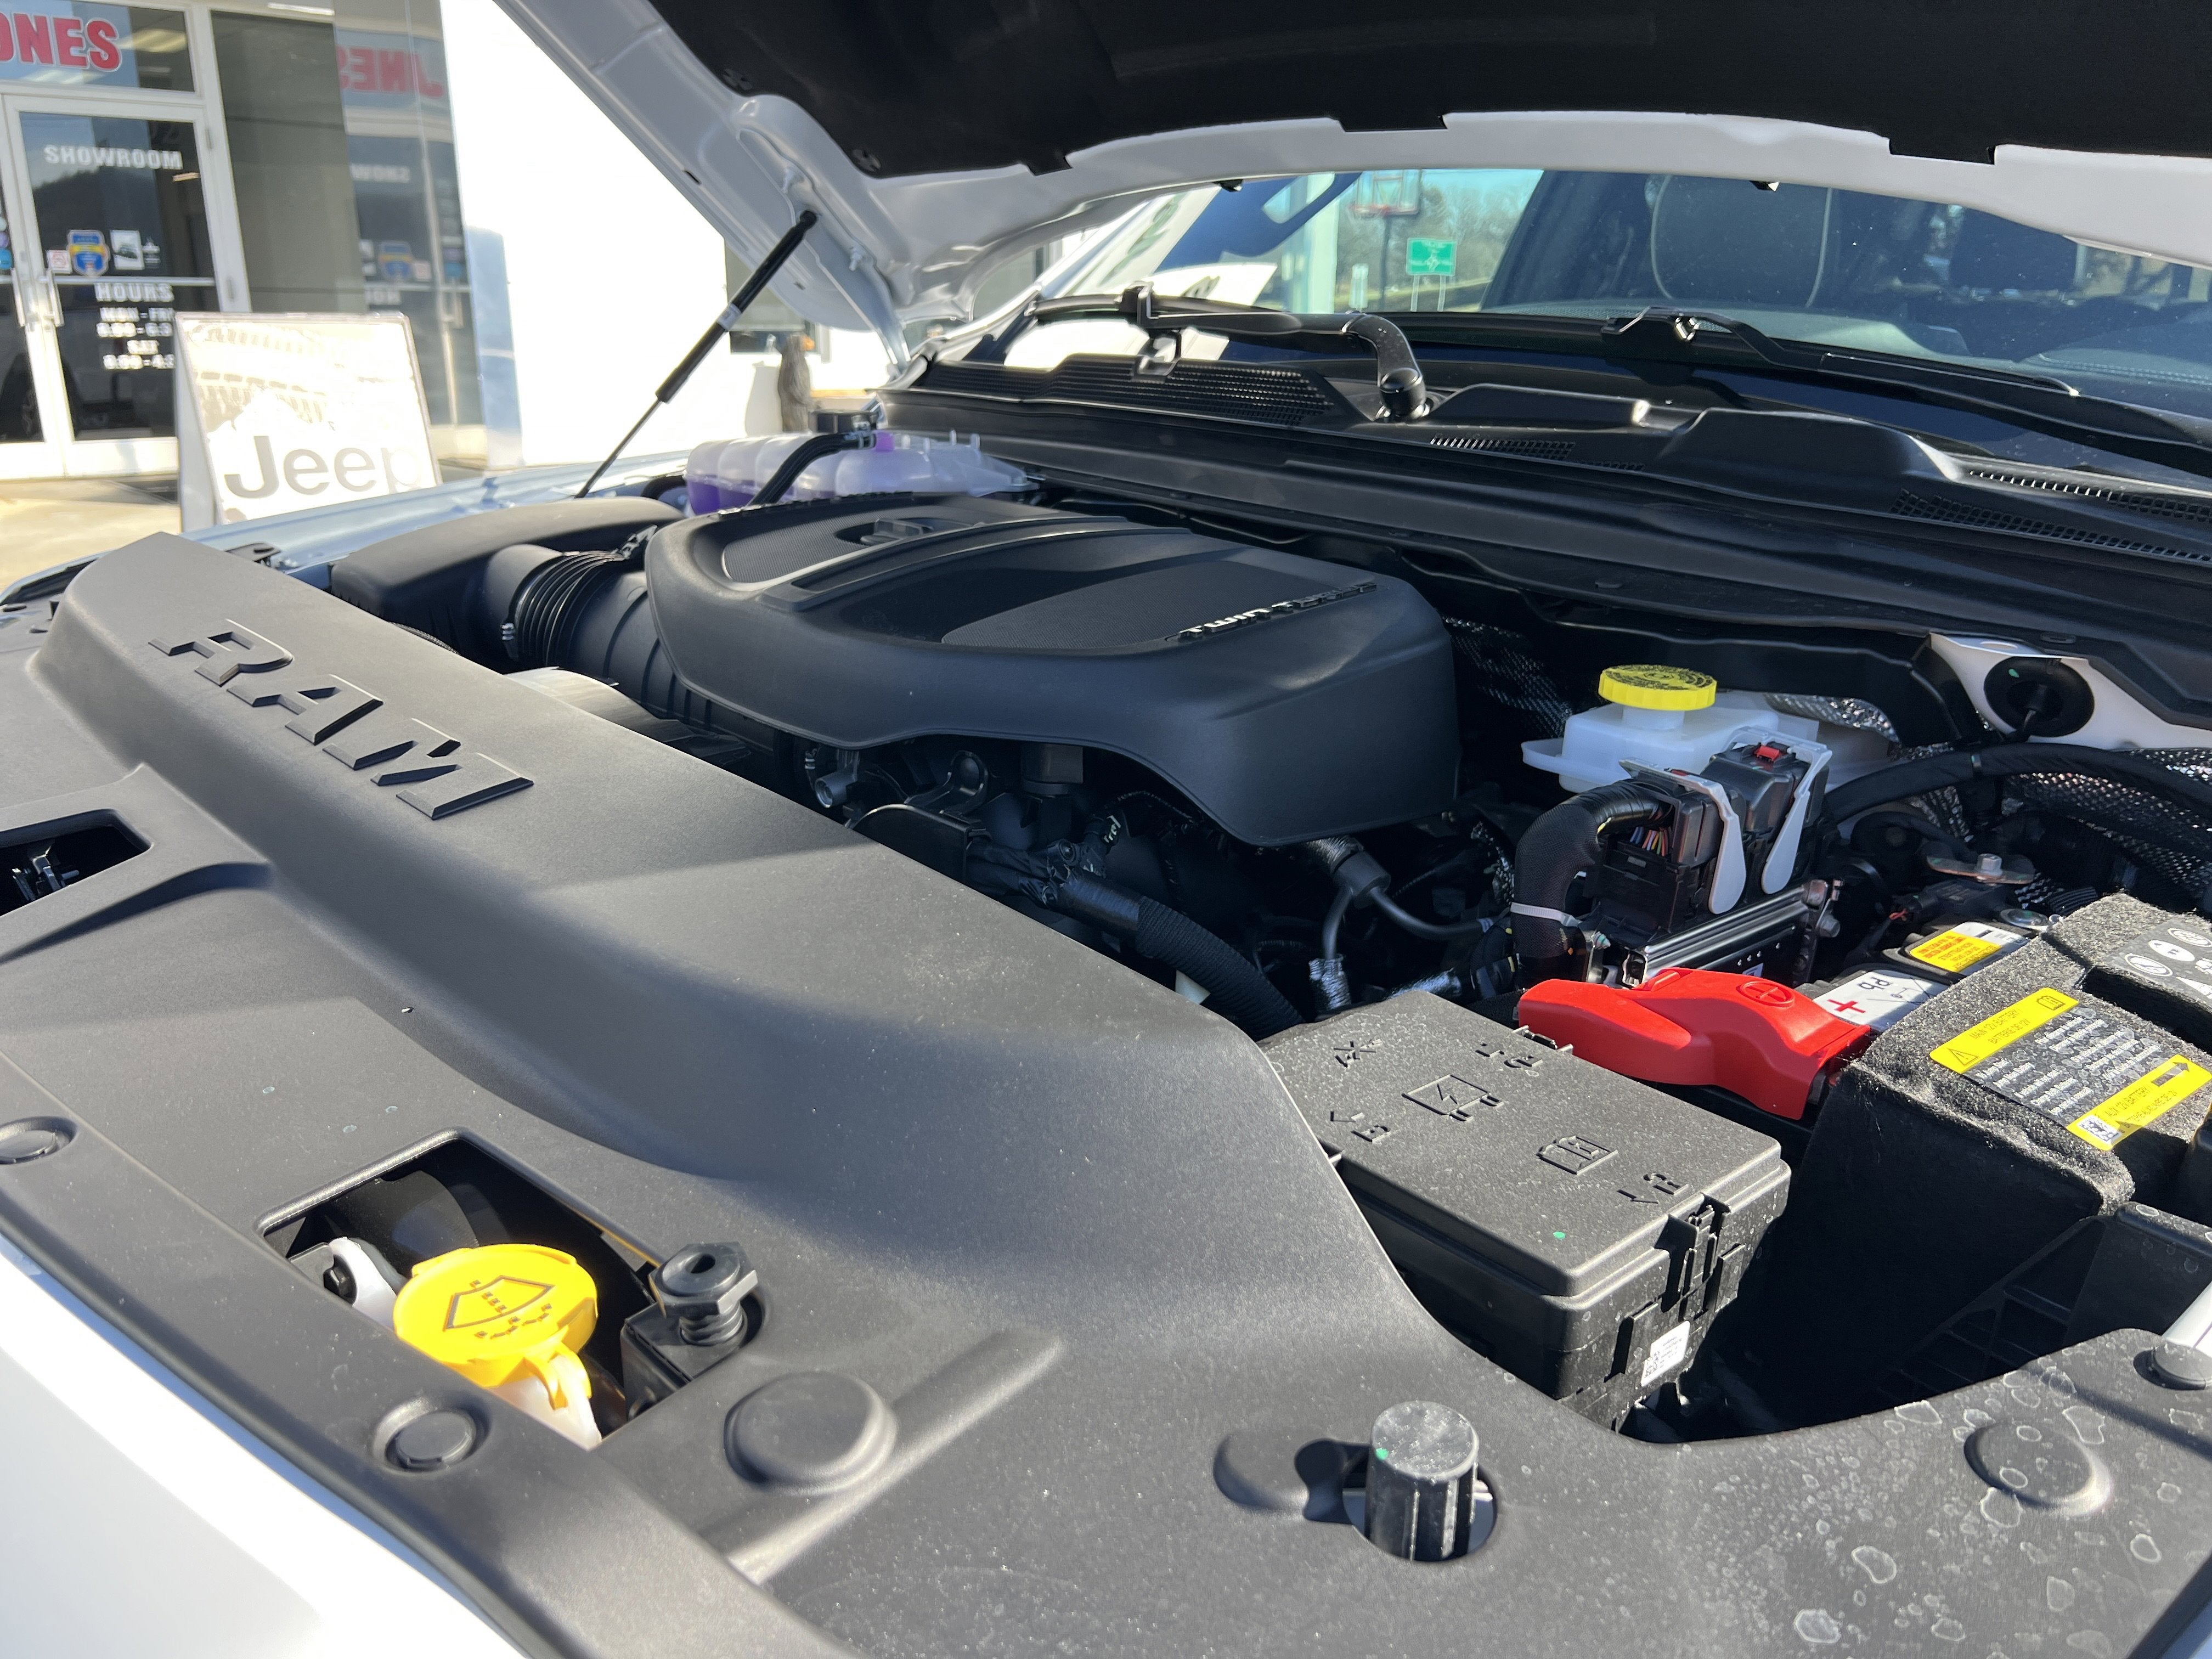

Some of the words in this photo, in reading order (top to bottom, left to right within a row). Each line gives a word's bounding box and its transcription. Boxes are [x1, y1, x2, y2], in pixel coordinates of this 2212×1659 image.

[43, 145, 184, 170] SHOWROOM
[94, 283, 174, 302] HOURS
[224, 436, 422, 499] Jeep
[148, 618, 534, 821] RAM
